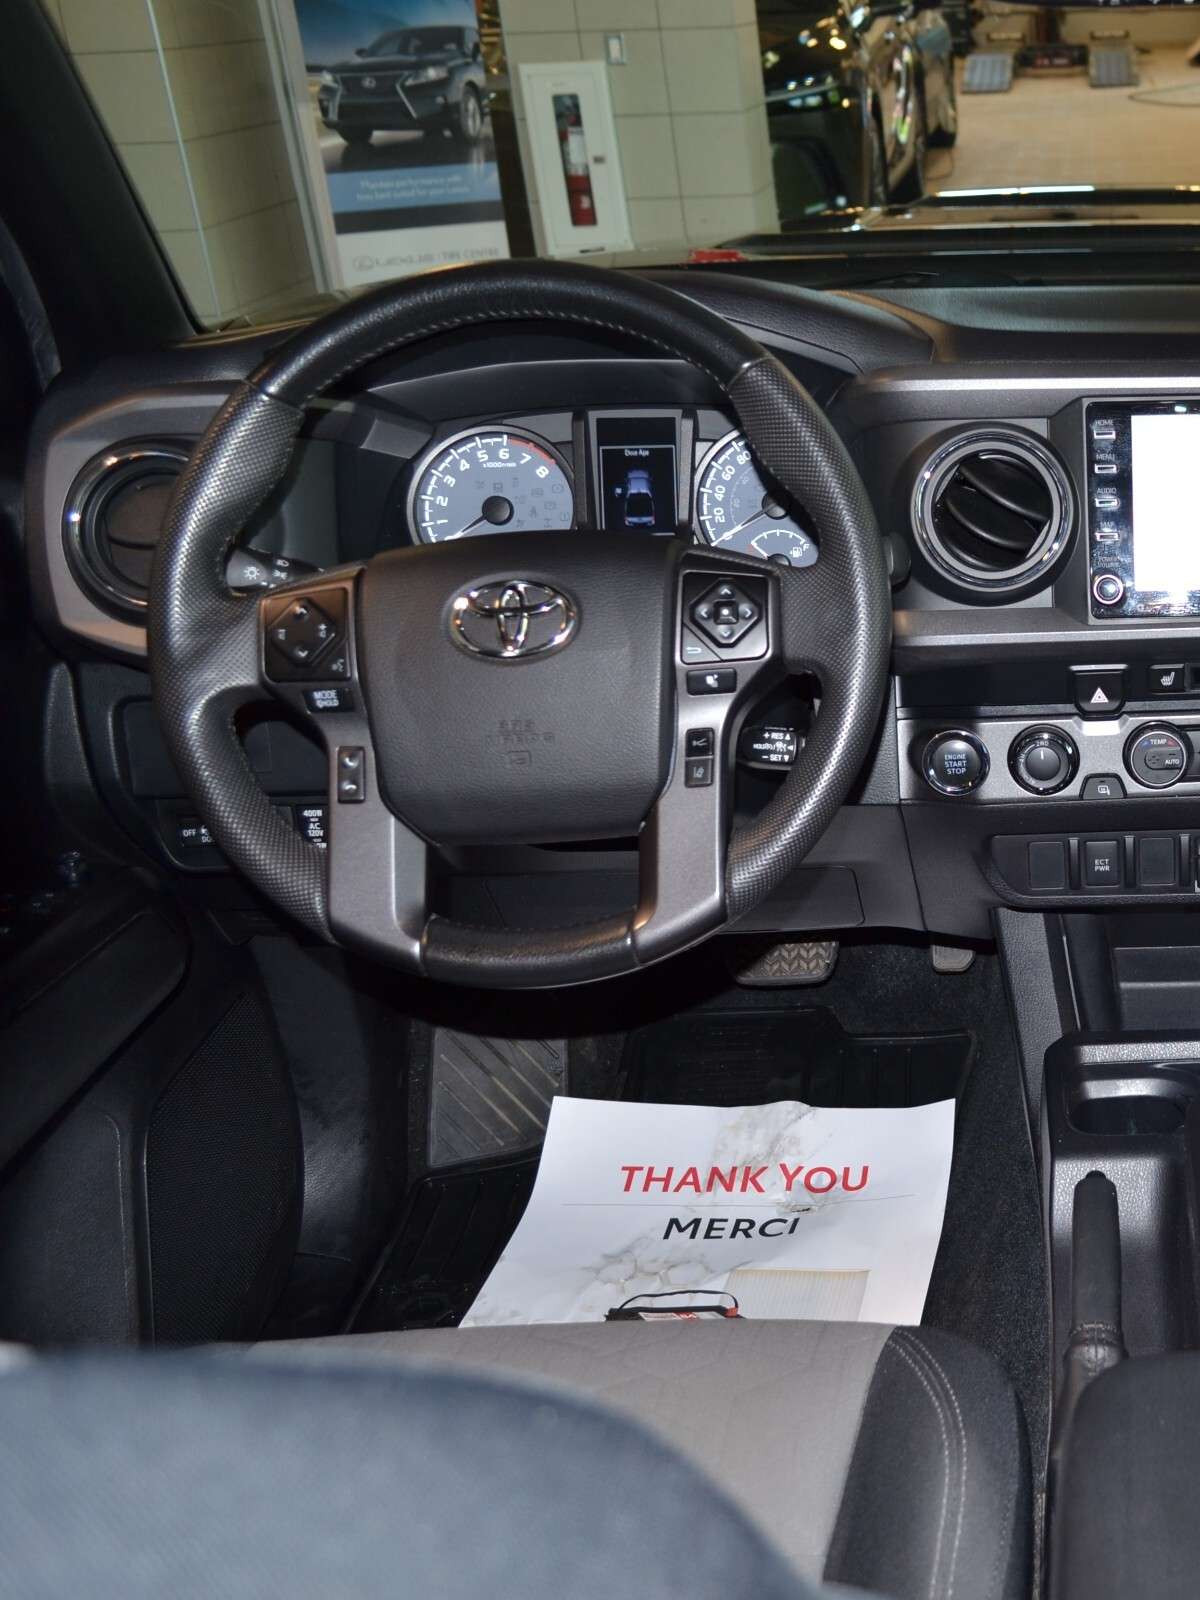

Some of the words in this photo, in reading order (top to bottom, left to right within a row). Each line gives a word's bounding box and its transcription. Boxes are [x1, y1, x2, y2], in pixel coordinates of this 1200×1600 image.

[477, 451, 489, 462] 5
[499, 448, 510, 459] 6
[520, 453, 532, 464] 7
[736, 451, 752, 465] 80
[459, 460, 470, 471] 4
[535, 466, 549, 478] 8
[722, 465, 735, 481] 60
[444, 475, 456, 487] 3
[714, 485, 726, 501] 40
[436, 496, 448, 507] 2
[713, 507, 726, 523] 20
[803, 543, 810, 551] F
[313, 690, 337, 699] MODE
[771, 732, 784, 740] RES
[182, 829, 196, 837] OFF
[621, 1165, 769, 1193] THANK
[779, 1163, 869, 1194] YOU
[662, 1217, 800, 1241] MERCI
